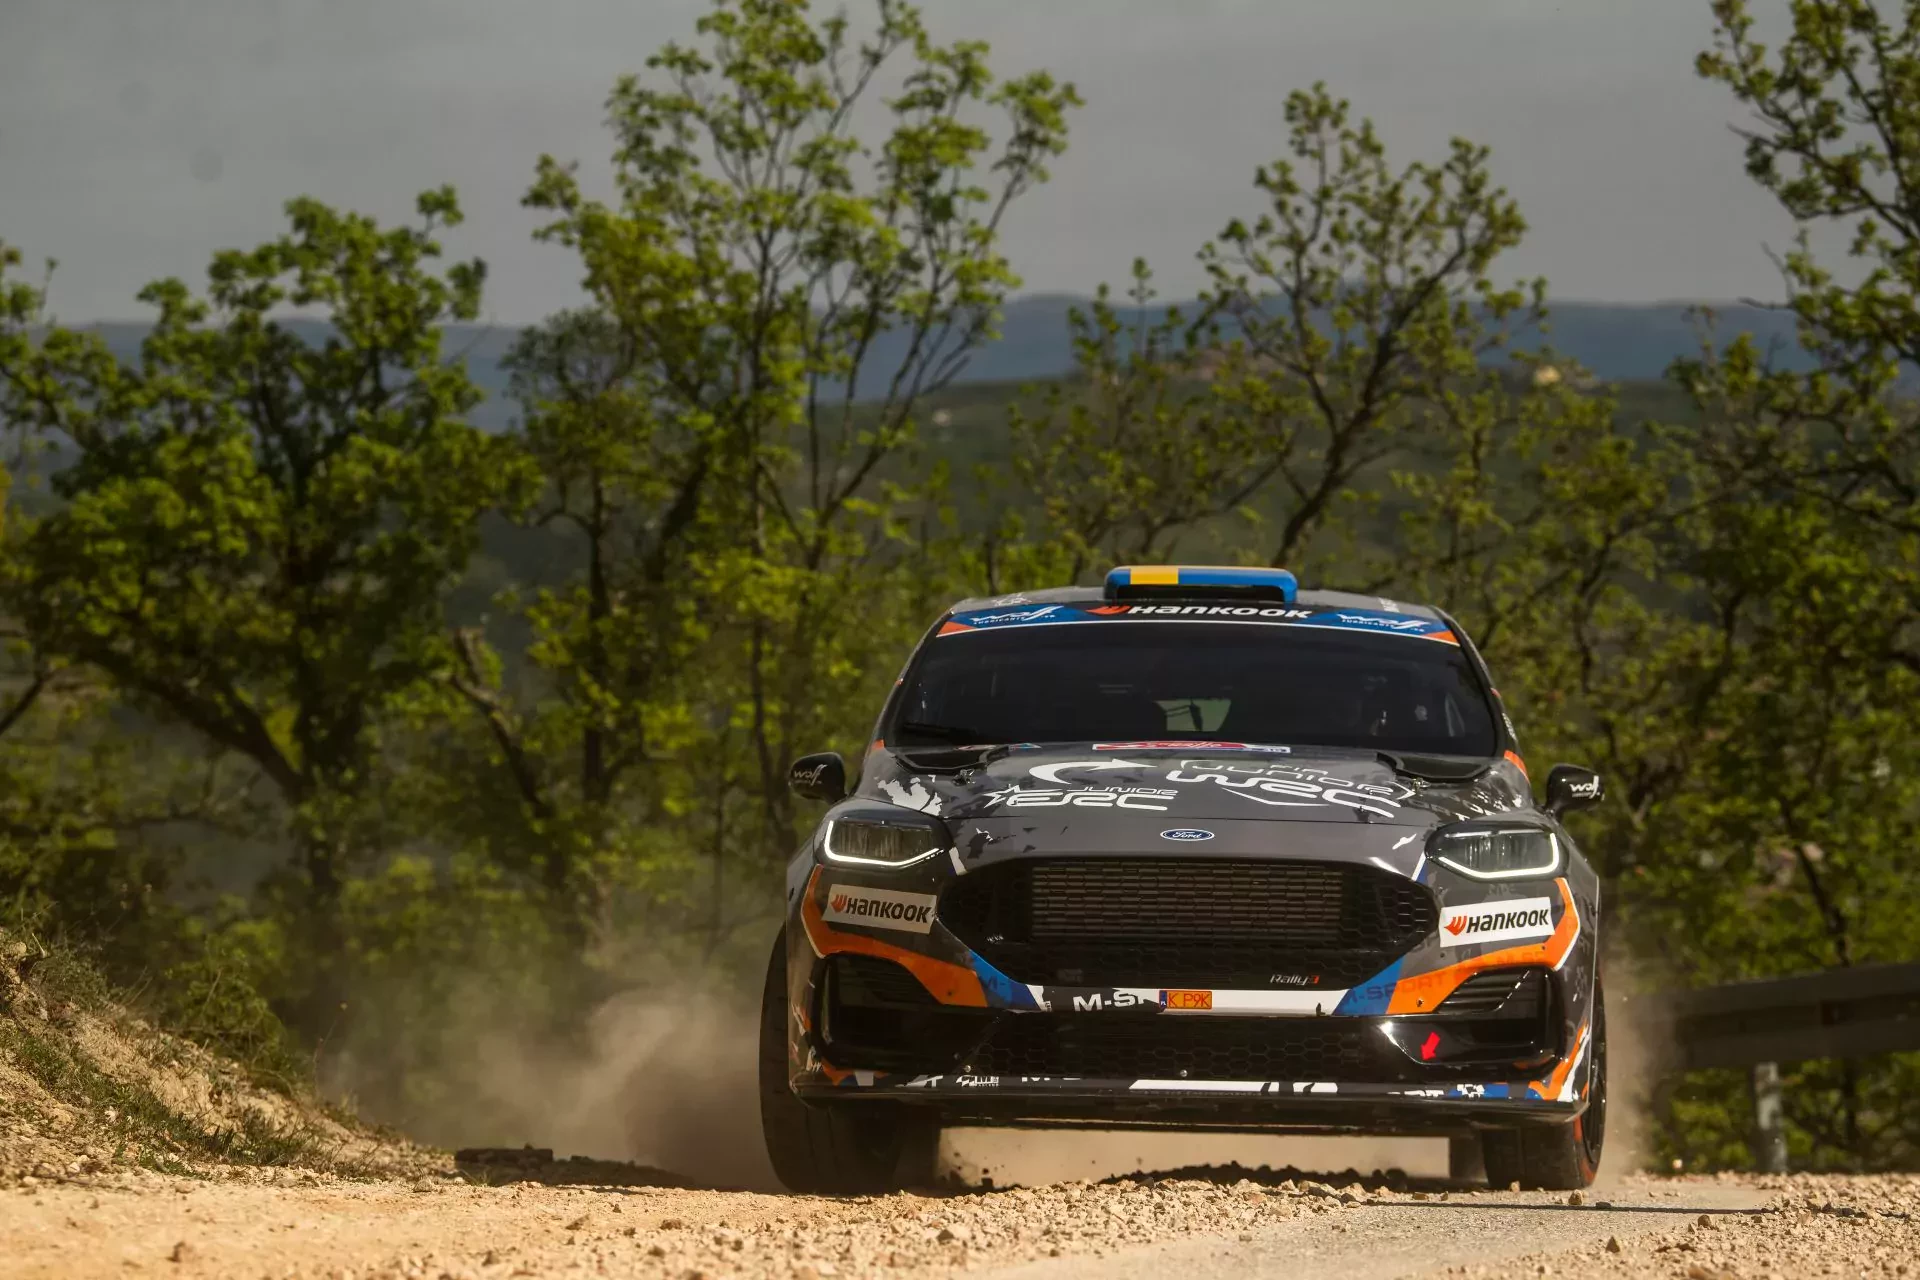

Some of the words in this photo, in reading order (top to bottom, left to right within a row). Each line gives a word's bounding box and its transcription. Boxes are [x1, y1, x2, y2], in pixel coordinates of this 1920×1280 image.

[1067, 786, 1179, 795] JUNIOR
[1192, 765, 1394, 796] JUNIOR
[1006, 792, 1175, 811] ERC
[1166, 770, 1401, 818] WRC
